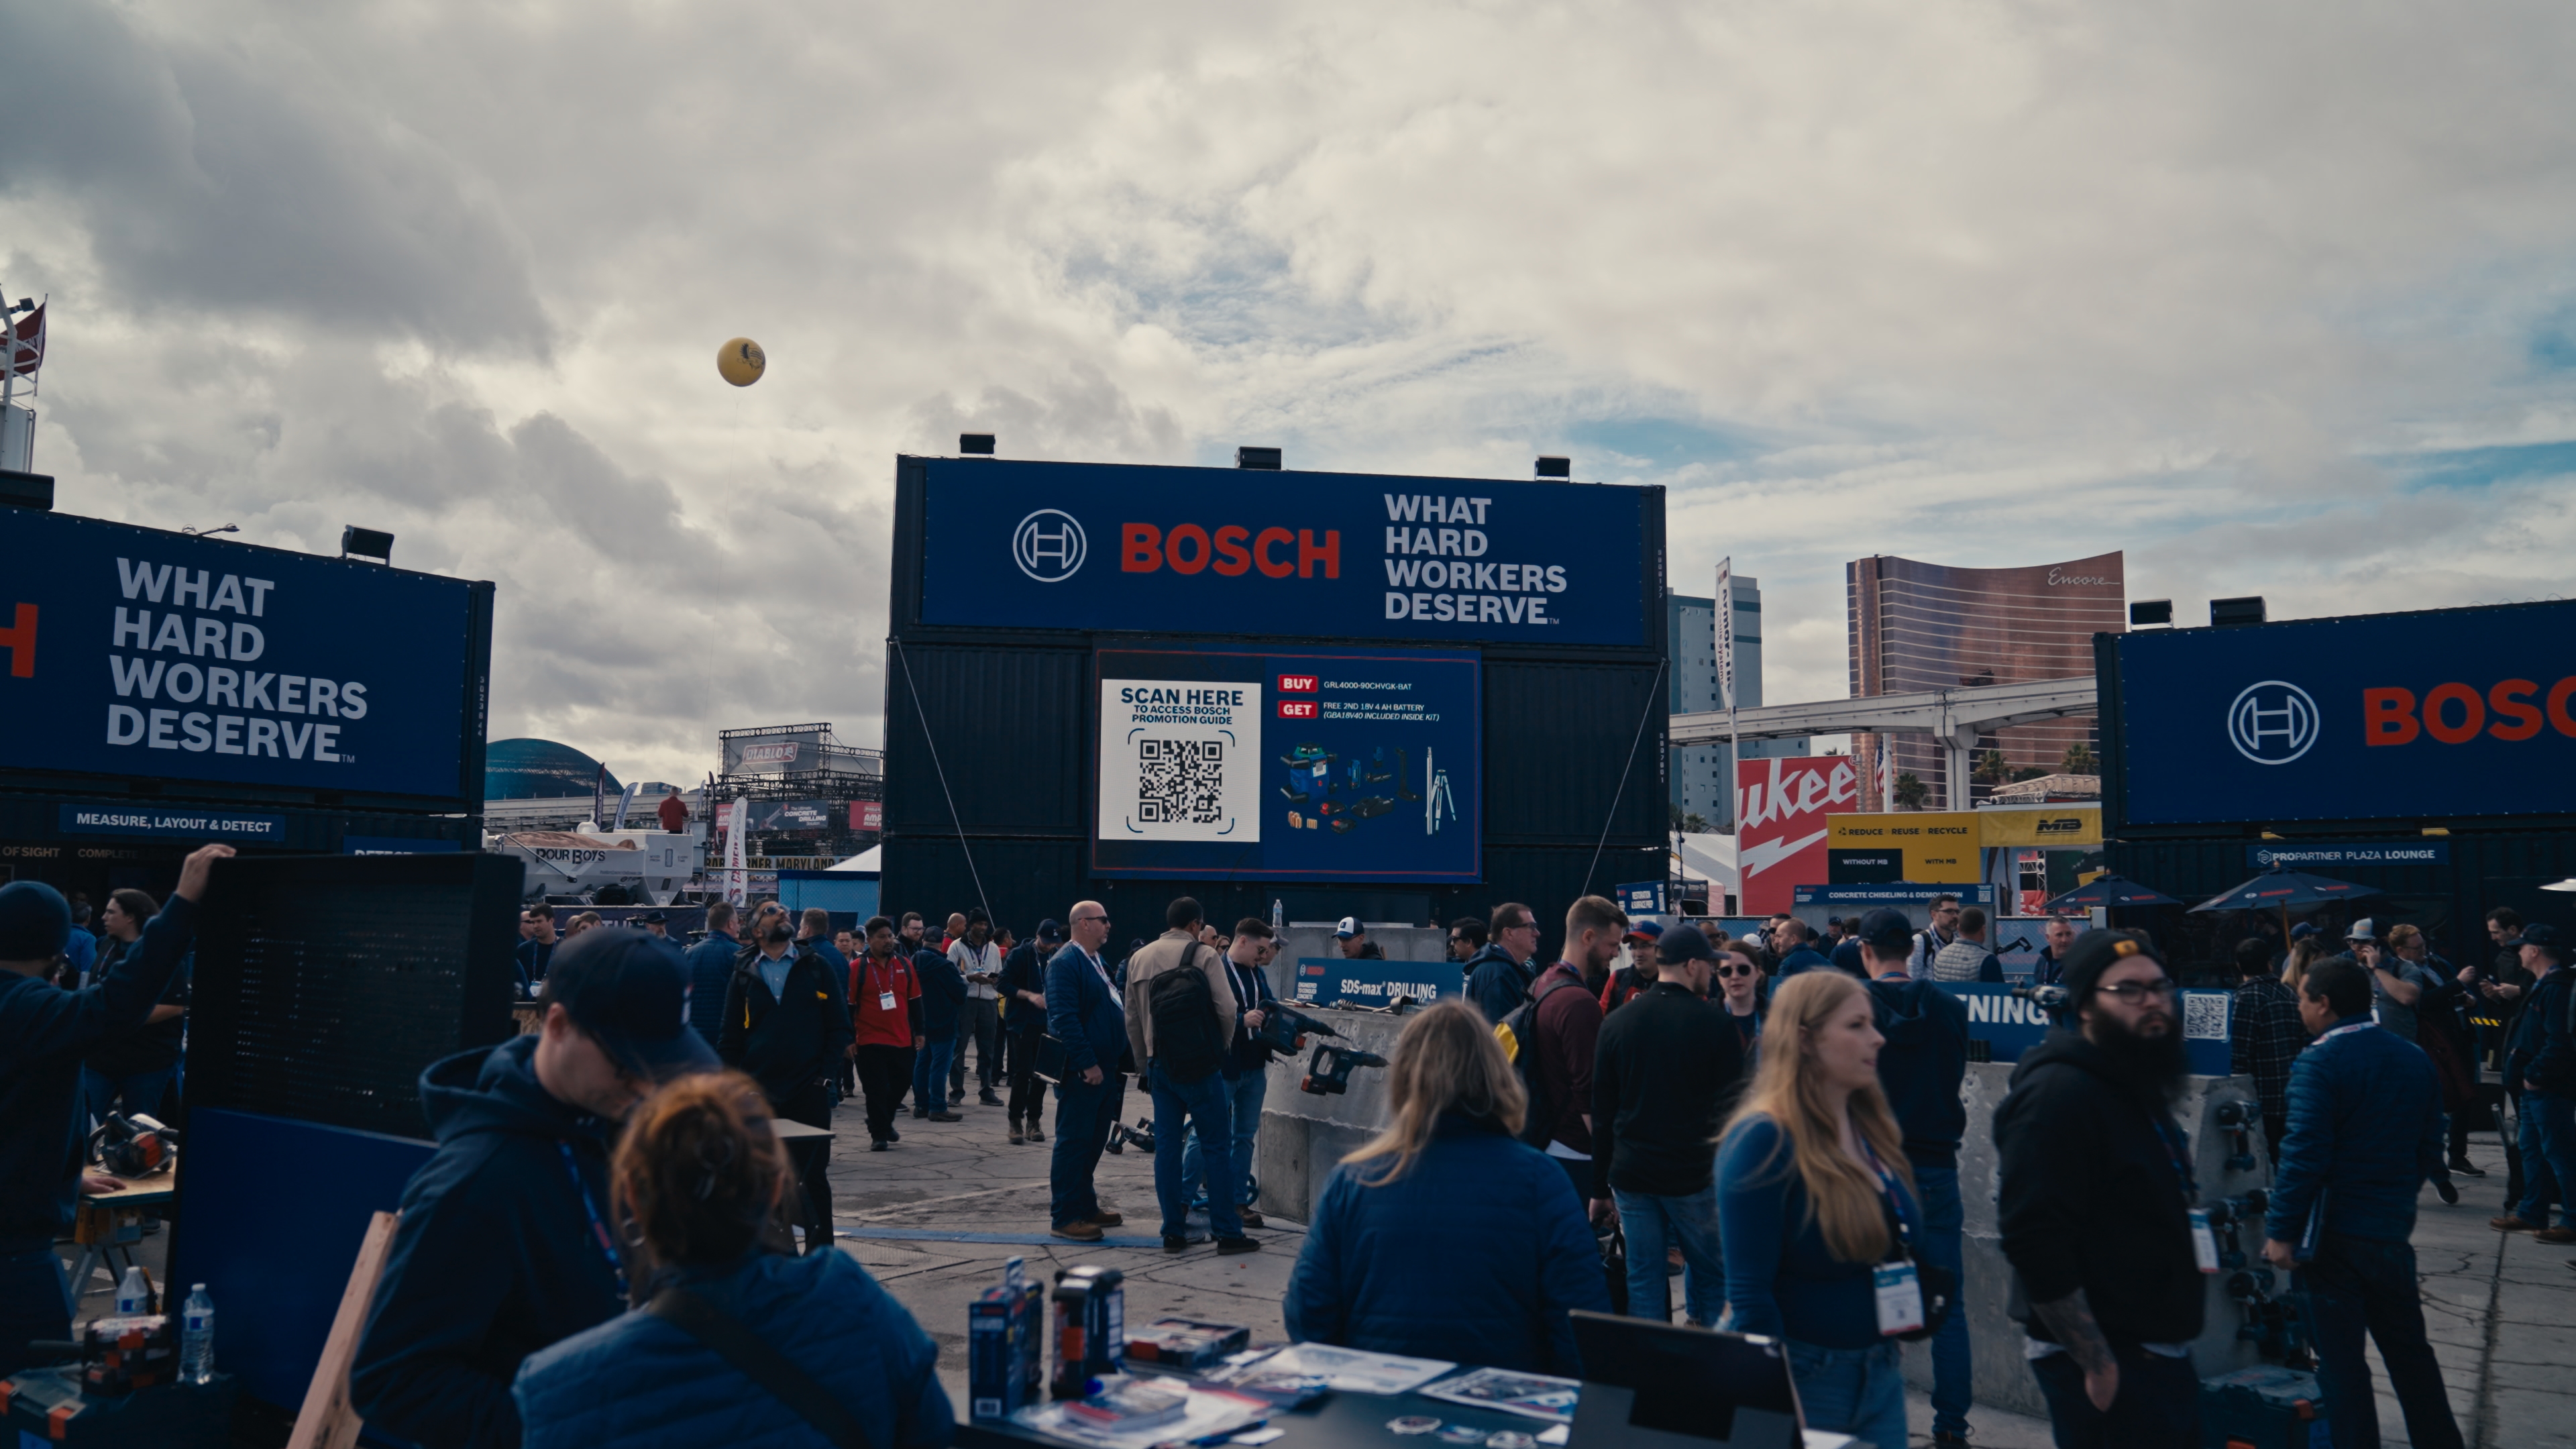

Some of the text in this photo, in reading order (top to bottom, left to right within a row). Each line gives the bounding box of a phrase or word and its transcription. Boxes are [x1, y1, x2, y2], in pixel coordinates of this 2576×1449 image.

[1384, 494, 1492, 525] WHAT
[1385, 526, 1488, 557] HARD
[1121, 522, 1340, 580] BOSCH
[1384, 559, 1567, 592] WORKERS
[2048, 567, 2121, 587] Encore
[117, 557, 274, 616] WHAT
[113, 606, 265, 662] HARD
[109, 655, 368, 720] WORKERS
[1283, 678, 1412, 690] BUY GRL4000-90CHVGK-BAT
[1121, 688, 1243, 706] SCAN HERE
[1134, 705, 1230, 715] TO ACCESS BOSCH
[1283, 704, 1312, 715] GET
[1324, 711, 1363, 719] (GBA18V40
[1132, 714, 1232, 724] PROMOTION GUIDE
[746, 745, 784, 760] DIABLO
[76, 813, 272, 833] MEASURE, LAYOUT & DETECT
[2037, 818, 2082, 830] MB
[2, 846, 60, 858] OF SIGHT
[78, 849, 138, 859] COMPLETE
[535, 847, 606, 864] POUR BOYS
[2272, 849, 2436, 861] PROPARTNER PLAZA LOUNGE
[776, 858, 835, 869] MARYLAND
[1387, 981, 1436, 1000] DRILLING
[1954, 994, 2050, 1025] NING
